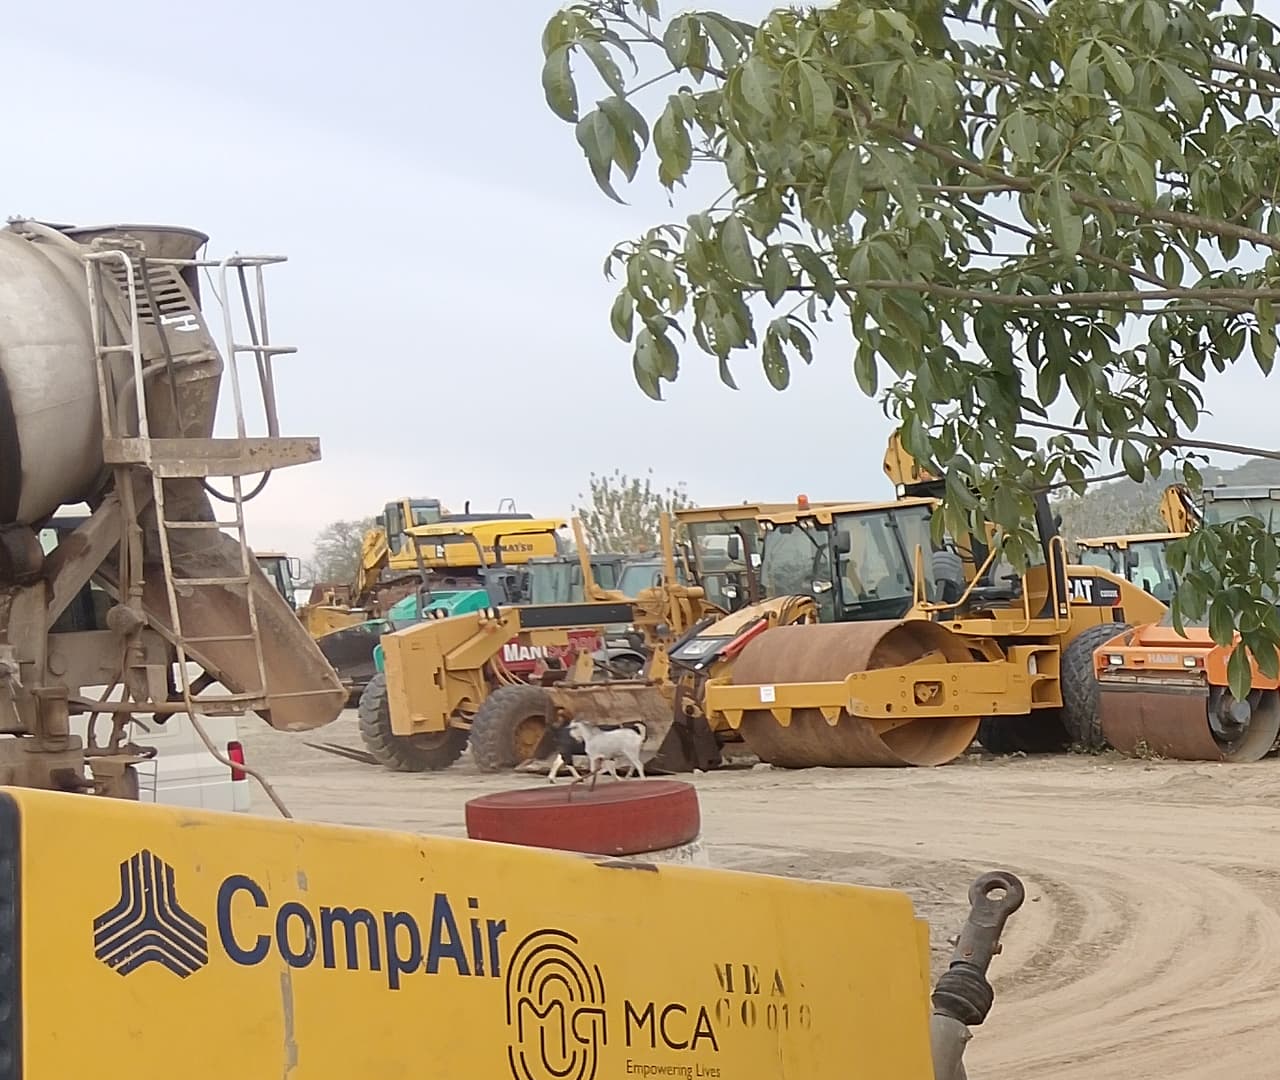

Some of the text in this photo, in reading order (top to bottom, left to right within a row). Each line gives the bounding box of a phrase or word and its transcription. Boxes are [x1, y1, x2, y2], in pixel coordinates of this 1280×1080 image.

[217, 875, 507, 990] CompAir
[624, 1000, 719, 1051] MCA
[626, 1060, 720, 1080] Empowering Lives
